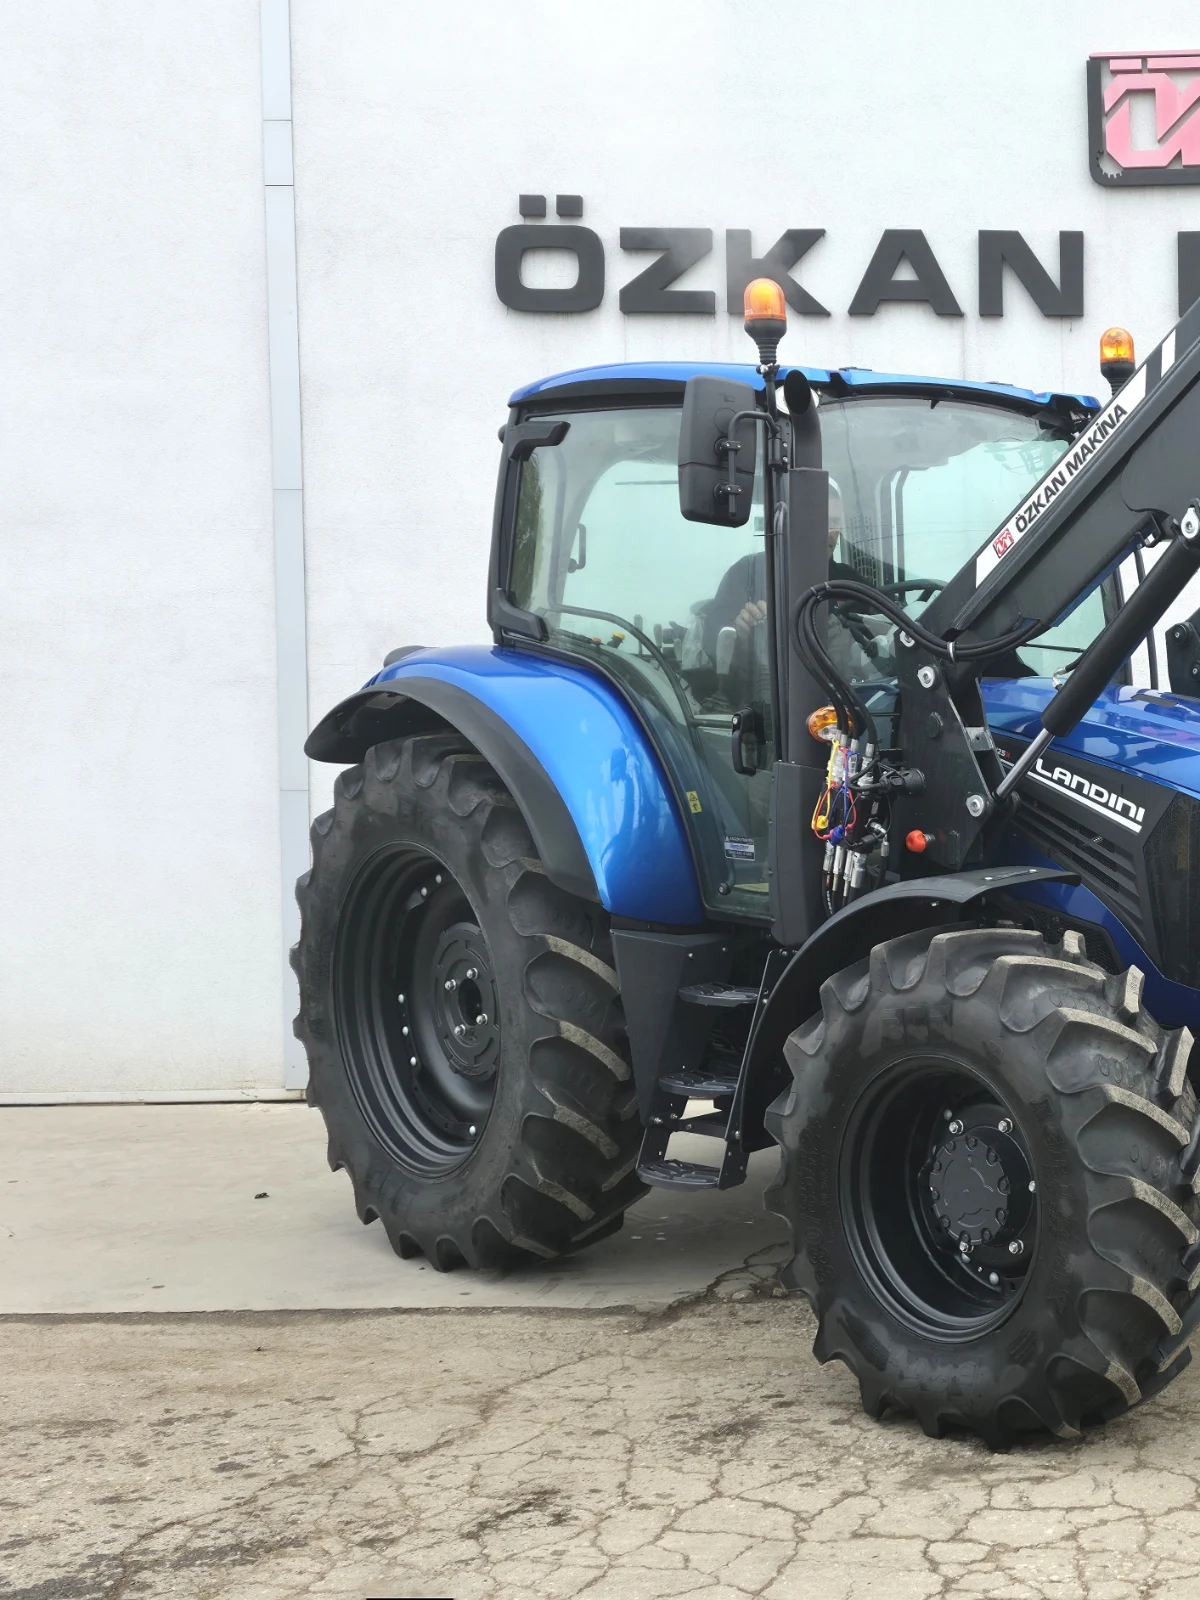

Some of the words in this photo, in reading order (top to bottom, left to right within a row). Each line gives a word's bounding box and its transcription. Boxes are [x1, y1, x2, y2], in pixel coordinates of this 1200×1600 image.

[495, 193, 1085, 317] ÖZKAN
[1015, 470, 1067, 534] ÖZKAN
[1065, 403, 1128, 477] MAKİNA
[1035, 757, 1146, 823] LANDINI
